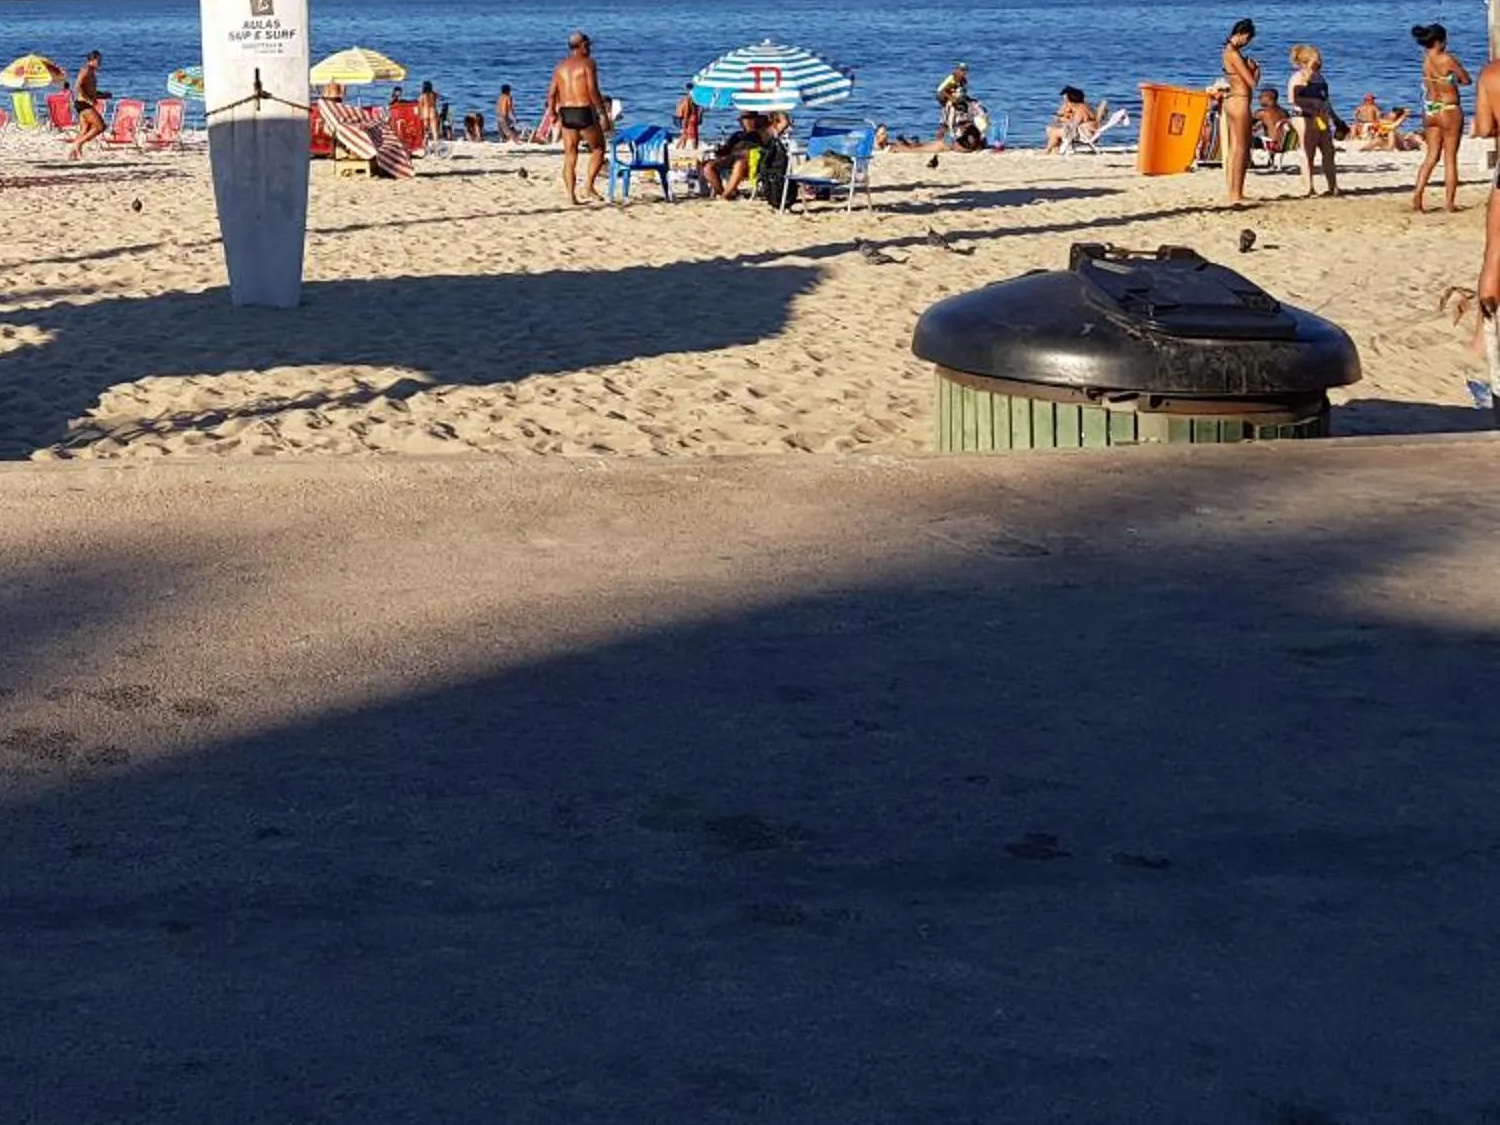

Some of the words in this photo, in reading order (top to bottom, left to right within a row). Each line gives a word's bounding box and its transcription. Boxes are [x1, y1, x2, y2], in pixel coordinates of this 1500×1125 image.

[242, 19, 281, 29] AULAS
[228, 30, 252, 41] SUP
[253, 30, 262, 40] E
[265, 28, 297, 40] SURF
